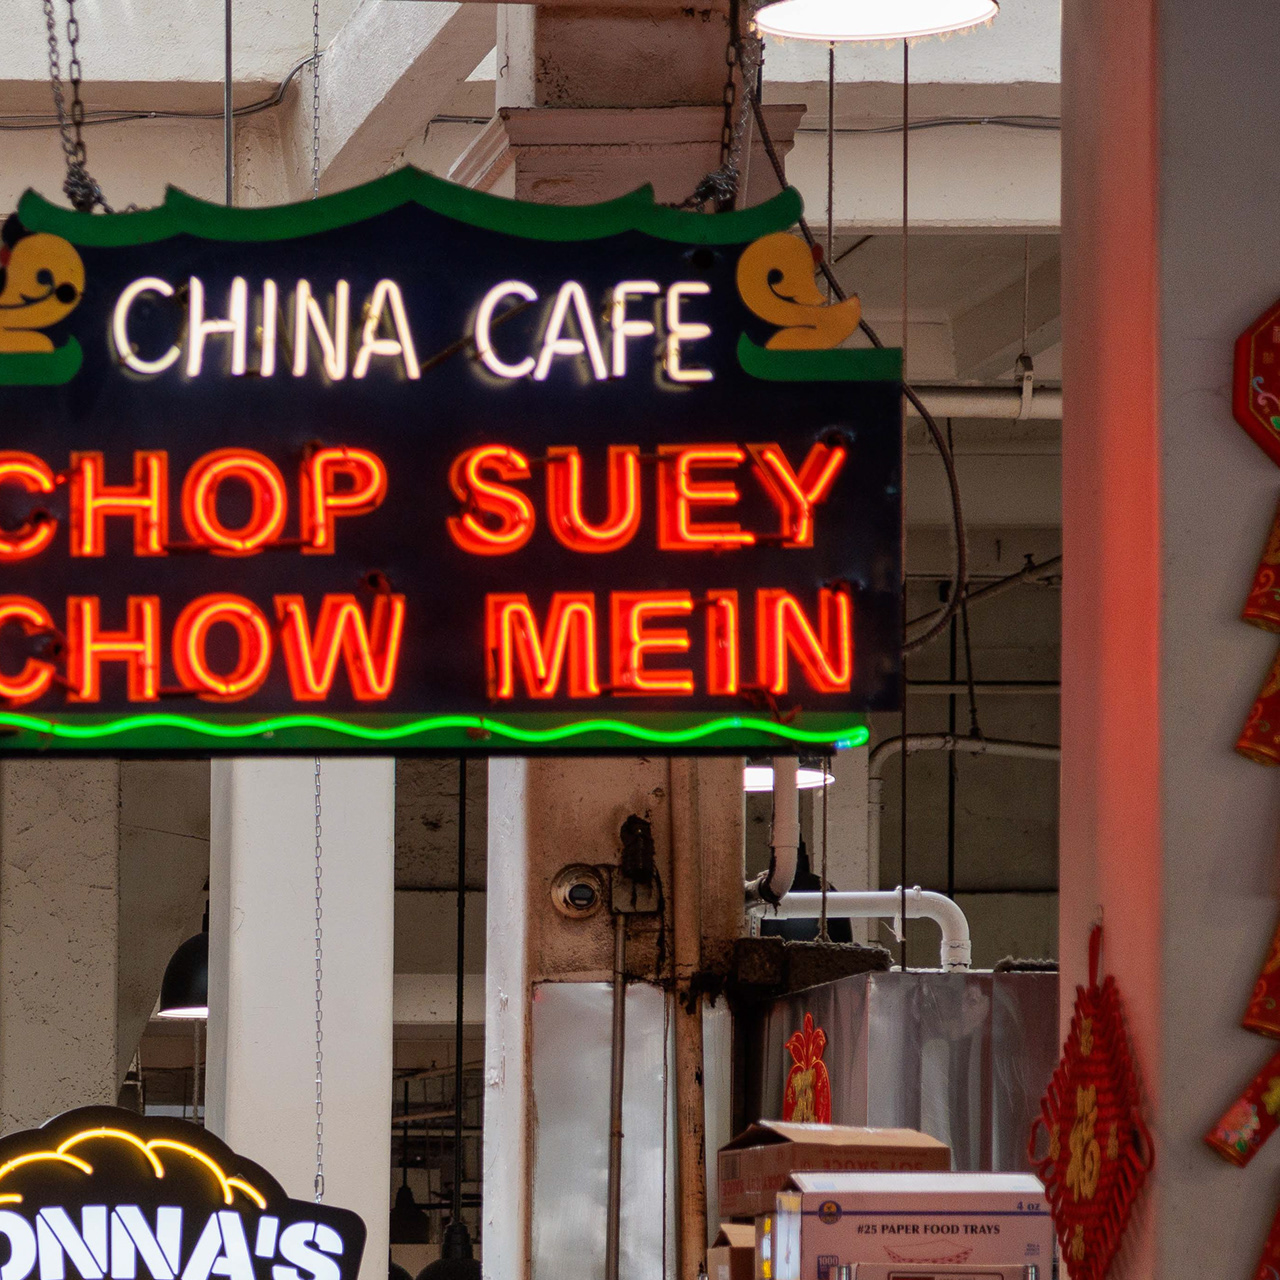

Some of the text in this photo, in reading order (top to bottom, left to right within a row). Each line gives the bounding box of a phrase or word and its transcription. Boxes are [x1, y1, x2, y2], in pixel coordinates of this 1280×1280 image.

[112, 276, 714, 386] CHINA CAFE
[446, 443, 846, 558] SUEY
[486, 589, 854, 701] MEIN
[857, 1224, 1001, 1235] #25 PAPER FOOD TRAYS
